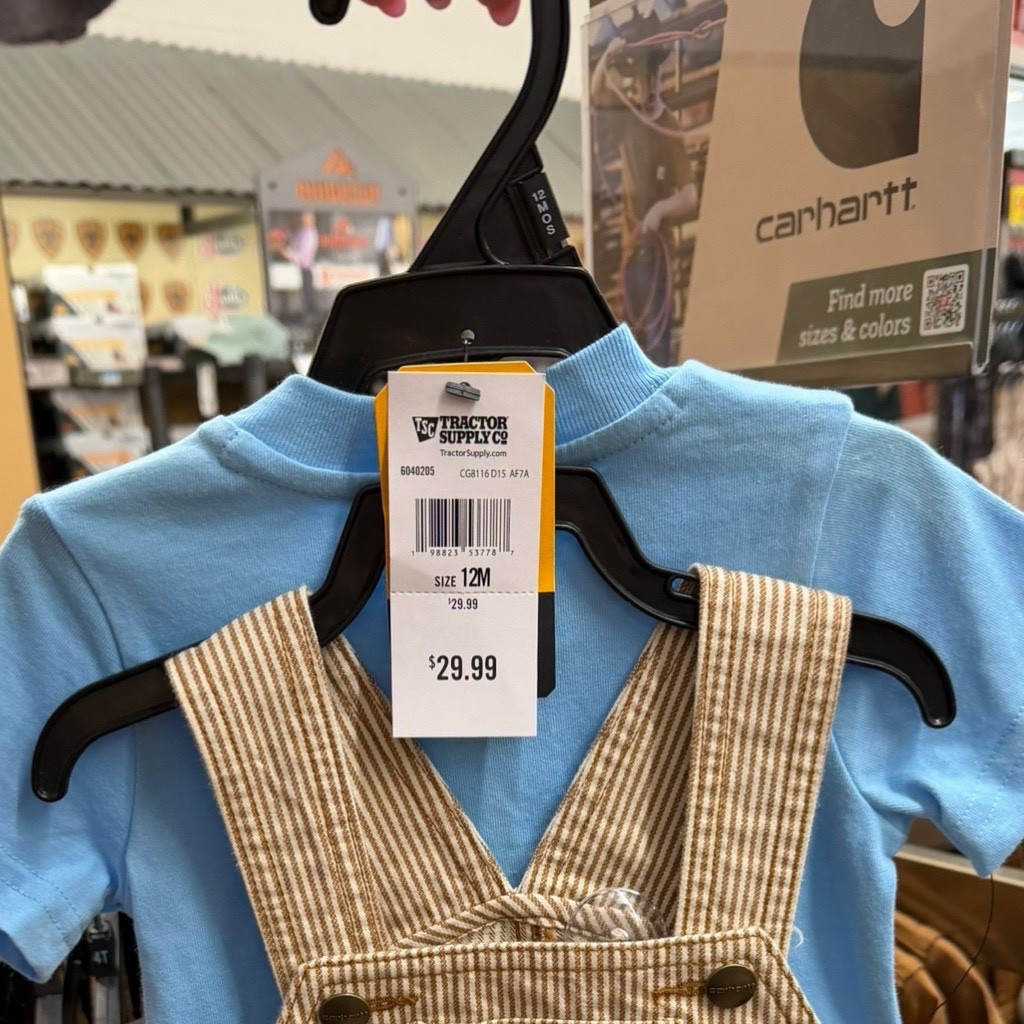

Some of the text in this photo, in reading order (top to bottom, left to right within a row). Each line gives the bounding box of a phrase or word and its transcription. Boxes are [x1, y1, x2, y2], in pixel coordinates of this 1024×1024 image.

[532, 189, 547, 201] 12
[756, 177, 917, 243] carhartt
[827, 283, 914, 313] Find more
[799, 313, 912, 347] sizes & colors
[414, 416, 507, 438] TSC TRACTOR
[439, 431, 491, 444] SUPPLY
[440, 449, 507, 458] TractorSupply.com
[400, 466, 529, 478] 6040205 CG8116 D15 AF7A
[434, 567, 491, 587] SIZE 12M
[448, 598, 478, 609] $29.99
[428, 654, 497, 681] $29.99
